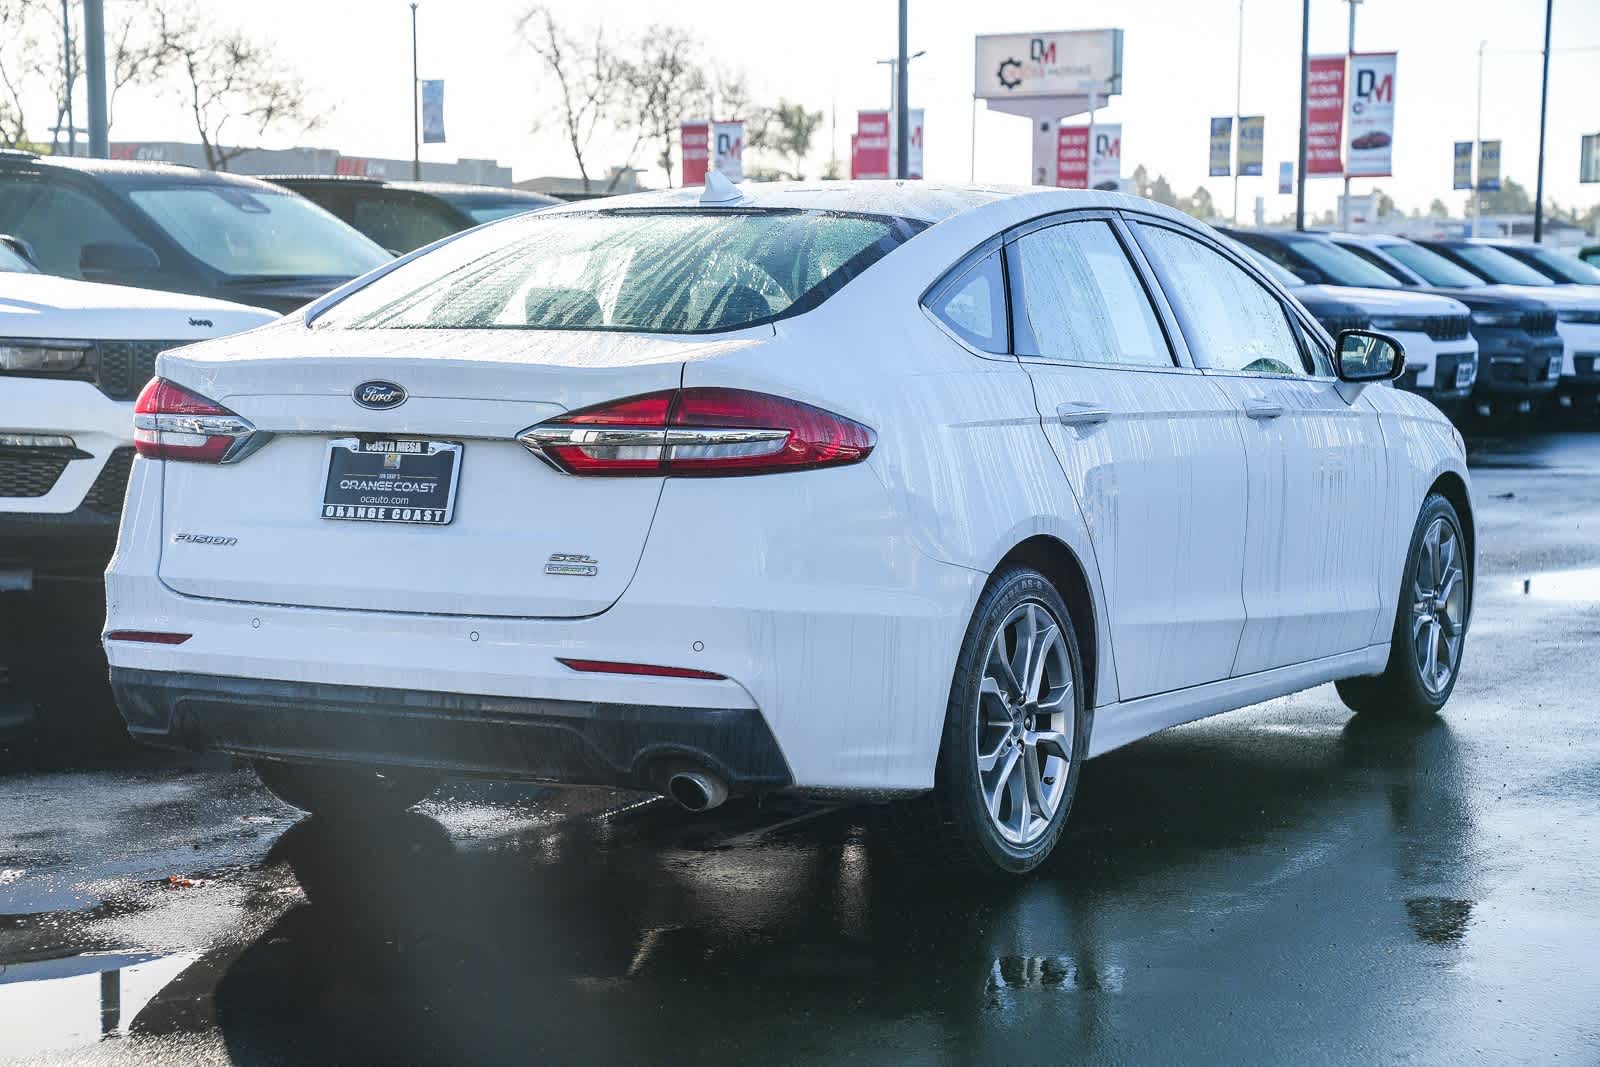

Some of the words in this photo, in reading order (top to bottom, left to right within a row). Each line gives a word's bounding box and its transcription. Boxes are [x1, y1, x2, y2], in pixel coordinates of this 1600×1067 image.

[1357, 69, 1392, 103] DM
[362, 386, 397, 401] Ford
[366, 441, 395, 452] COSTA
[396, 441, 421, 452] MESA
[360, 495, 409, 505] ocauto.com
[325, 507, 386, 519] ORANGE
[391, 510, 443, 522] COAST
[175, 533, 238, 546] FUSION
[549, 554, 598, 563] SEL
